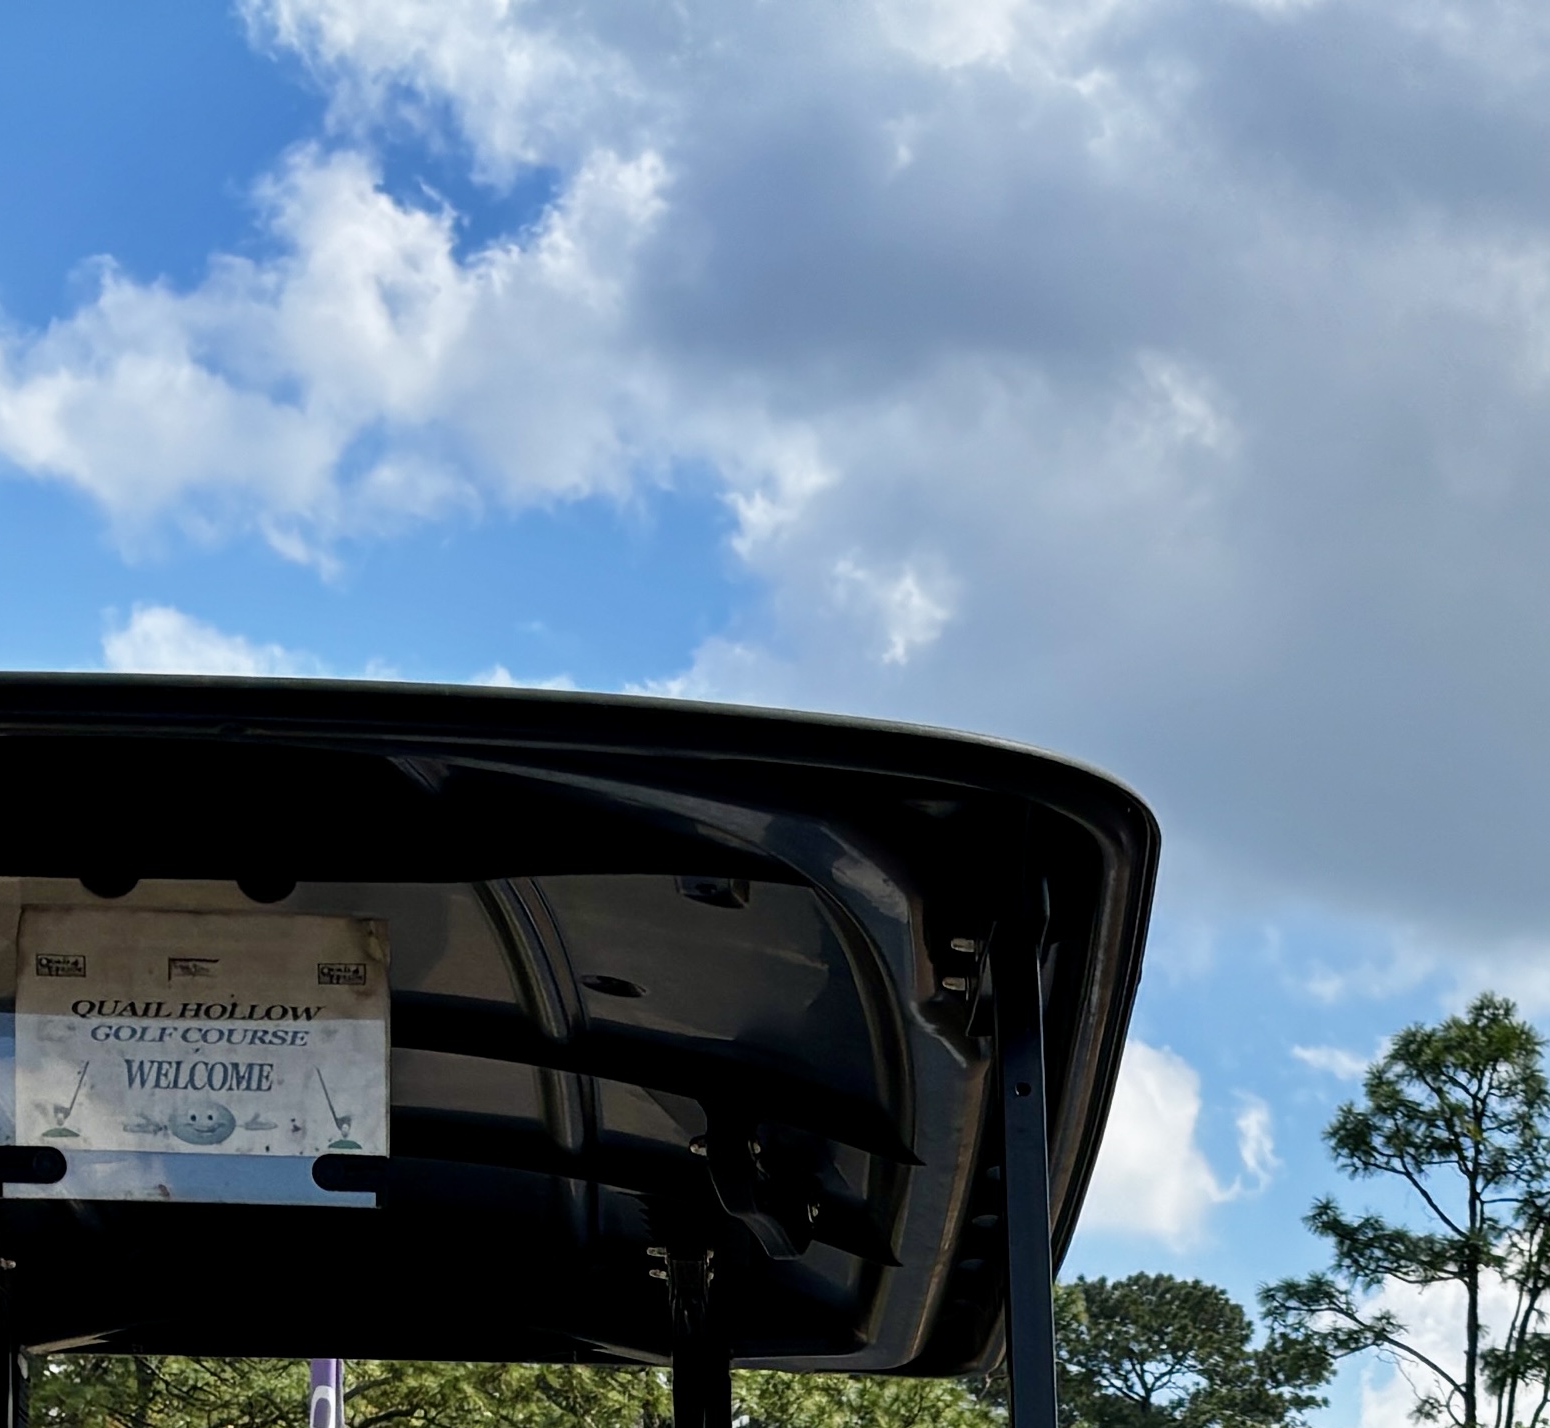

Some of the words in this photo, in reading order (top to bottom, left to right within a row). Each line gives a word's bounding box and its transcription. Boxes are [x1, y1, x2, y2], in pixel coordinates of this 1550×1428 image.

[70, 999, 174, 1021] QUAIL
[178, 1001, 324, 1022] HOLLOW
[90, 1024, 179, 1044] GOLF
[182, 1026, 309, 1047] COURSE
[124, 1058, 274, 1092] WELCOME
